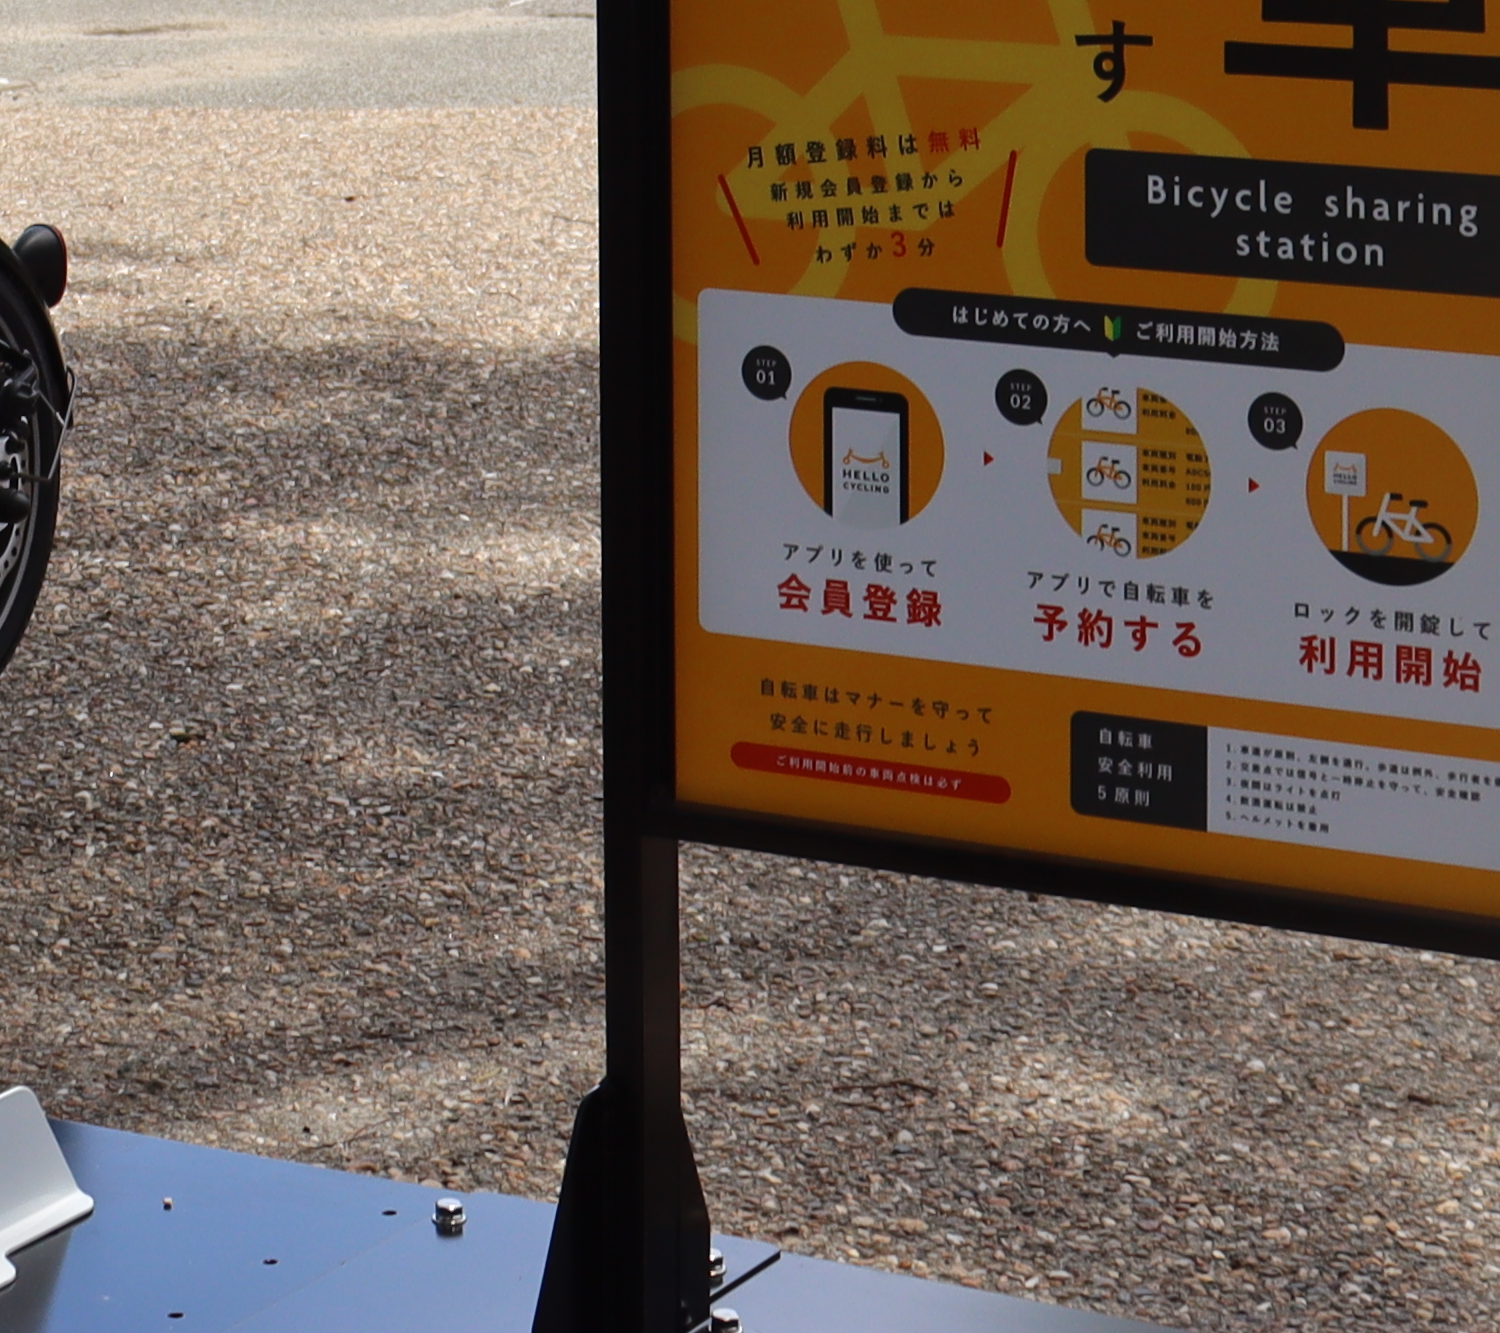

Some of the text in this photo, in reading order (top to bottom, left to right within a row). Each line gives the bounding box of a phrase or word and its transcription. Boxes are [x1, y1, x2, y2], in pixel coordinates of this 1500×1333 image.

[770, 168, 964, 203] 新規会員登録から
[786, 200, 956, 231] 利用開始までは
[1147, 174, 1479, 238] Bicycle sharing
[816, 231, 936, 265] わずか3分
[1235, 230, 1385, 267] station
[952, 305, 1280, 353] はじめての方へ ご利用開始方法
[756, 358, 777, 368] STEP
[756, 370, 776, 385] 01
[1009, 393, 1031, 410] 02
[1263, 417, 1286, 434] 03
[842, 469, 890, 482] HELLO
[843, 482, 890, 494] CYCLING
[783, 542, 937, 577] アプリを使って
[777, 573, 942, 627] 会員登録
[1027, 570, 1214, 610] アプリで自転車を
[1033, 603, 1202, 658] 予約する
[1294, 602, 1491, 640] ロックを開錠して
[1299, 634, 1482, 693] 利用開始
[760, 678, 993, 724] 自転車はマナーを守って
[769, 712, 980, 757] 安全に走行しましょう
[1099, 728, 1152, 749] 自転車
[1098, 756, 1173, 782] 安全利用
